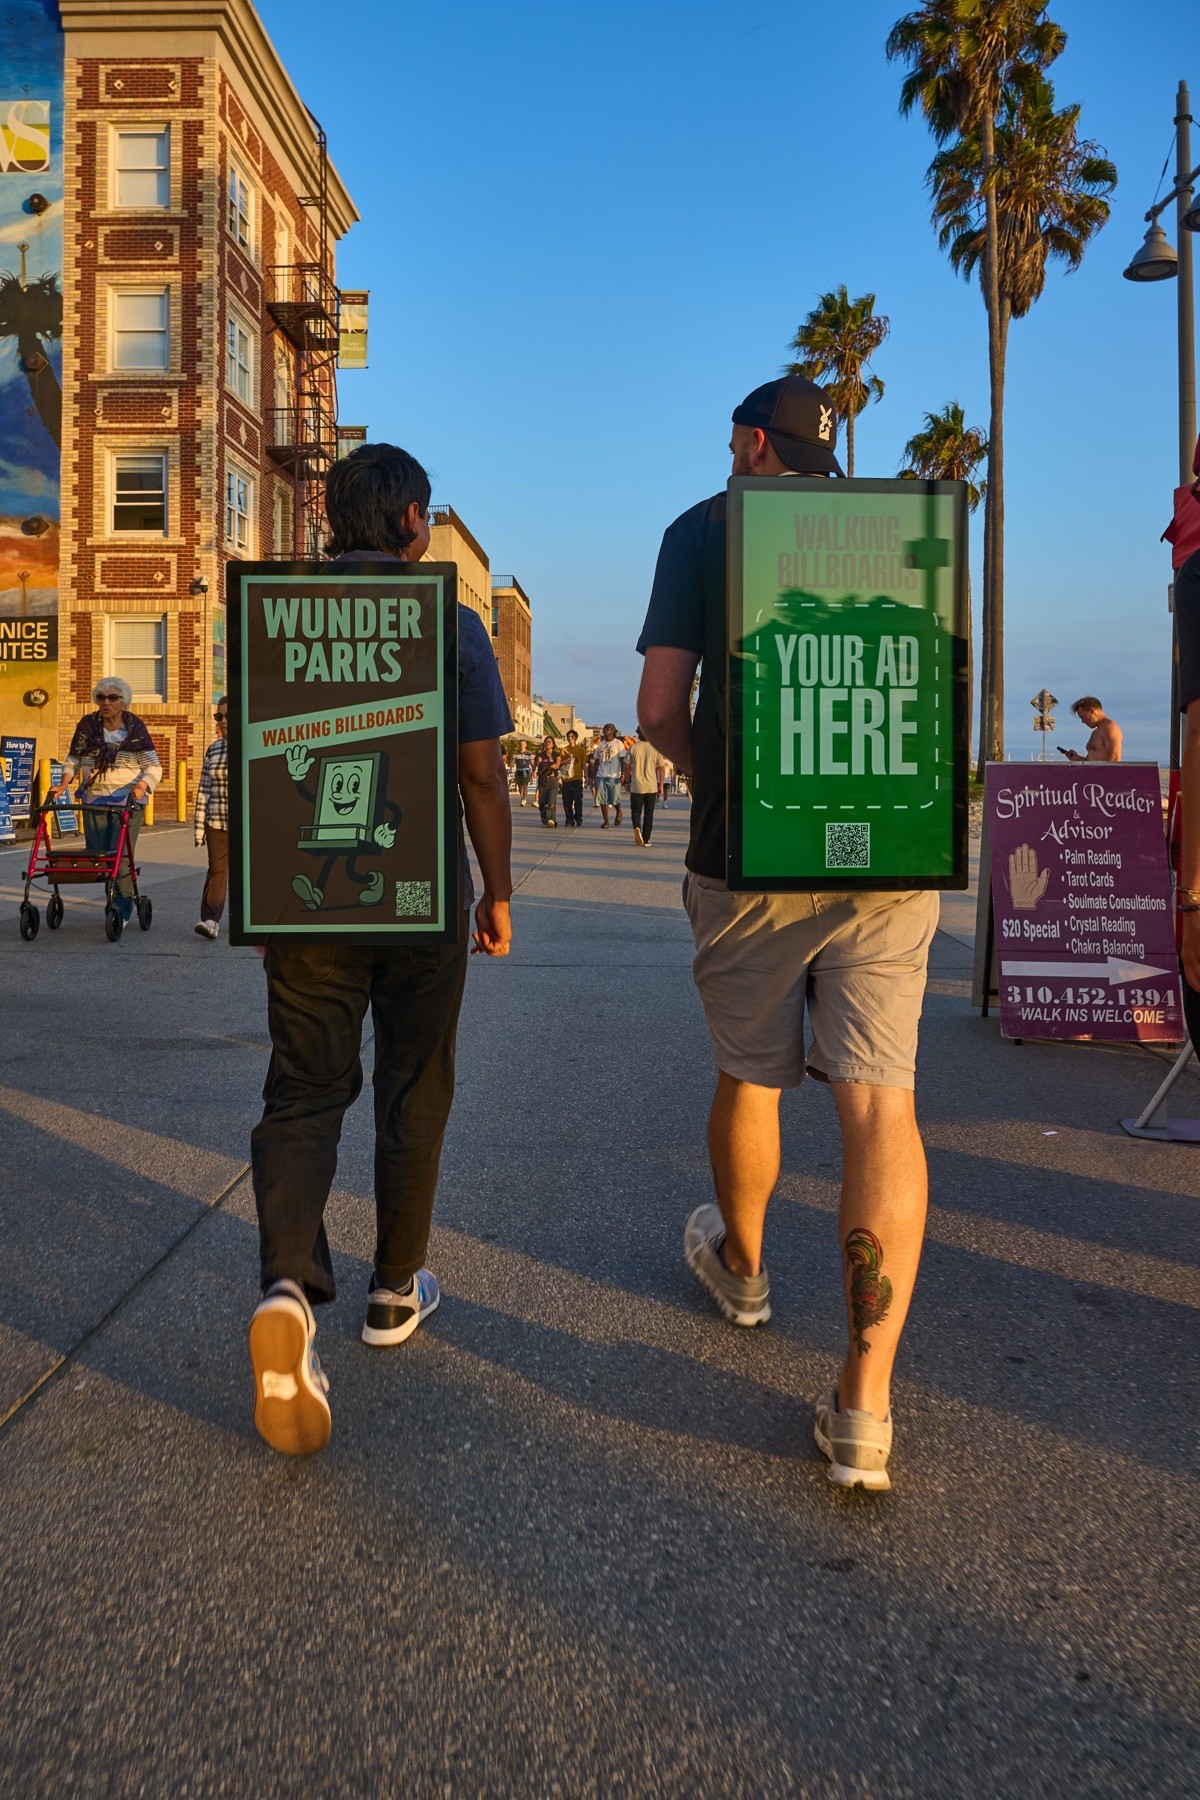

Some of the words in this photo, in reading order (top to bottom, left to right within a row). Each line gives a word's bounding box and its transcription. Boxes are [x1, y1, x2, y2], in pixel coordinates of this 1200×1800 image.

[794, 514, 901, 552] WALKING
[777, 552, 918, 591] BILLBOARDS
[262, 597, 422, 639] WUNDER
[285, 641, 402, 683] PARKS
[775, 633, 863, 687] YOUR
[875, 635, 919, 688] AD
[262, 719, 331, 748] WALKING
[335, 703, 425, 735] BILLBOARDS
[780, 688, 918, 776] HERE
[6, 741, 18, 749] How
[25, 742, 34, 751] Pay
[996, 783, 1079, 819] Spiritual
[1083, 783, 1155, 818] Reader
[1073, 809, 1080, 819] &
[1041, 821, 1113, 845] Advisor
[1065, 850, 1086, 865] Palm
[1087, 851, 1122, 869] Reading
[1066, 872, 1088, 887] Tarot
[1090, 873, 1114, 888] Cards
[1068, 894, 1107, 909] Soulmate
[1109, 894, 1167, 911] Consultations
[1002, 919, 1021, 938] $20
[1023, 920, 1060, 941] Special
[1070, 917, 1100, 935] Crystal
[1101, 918, 1136, 936] Reading
[1071, 939, 1101, 954] Chakra
[1103, 940, 1145, 959] Balancing
[1007, 985, 1176, 1007] 310.452.1394
[1021, 1008, 1061, 1022] WALK
[1065, 1008, 1088, 1022] INS
[1092, 1009, 1165, 1024] WELCOME
